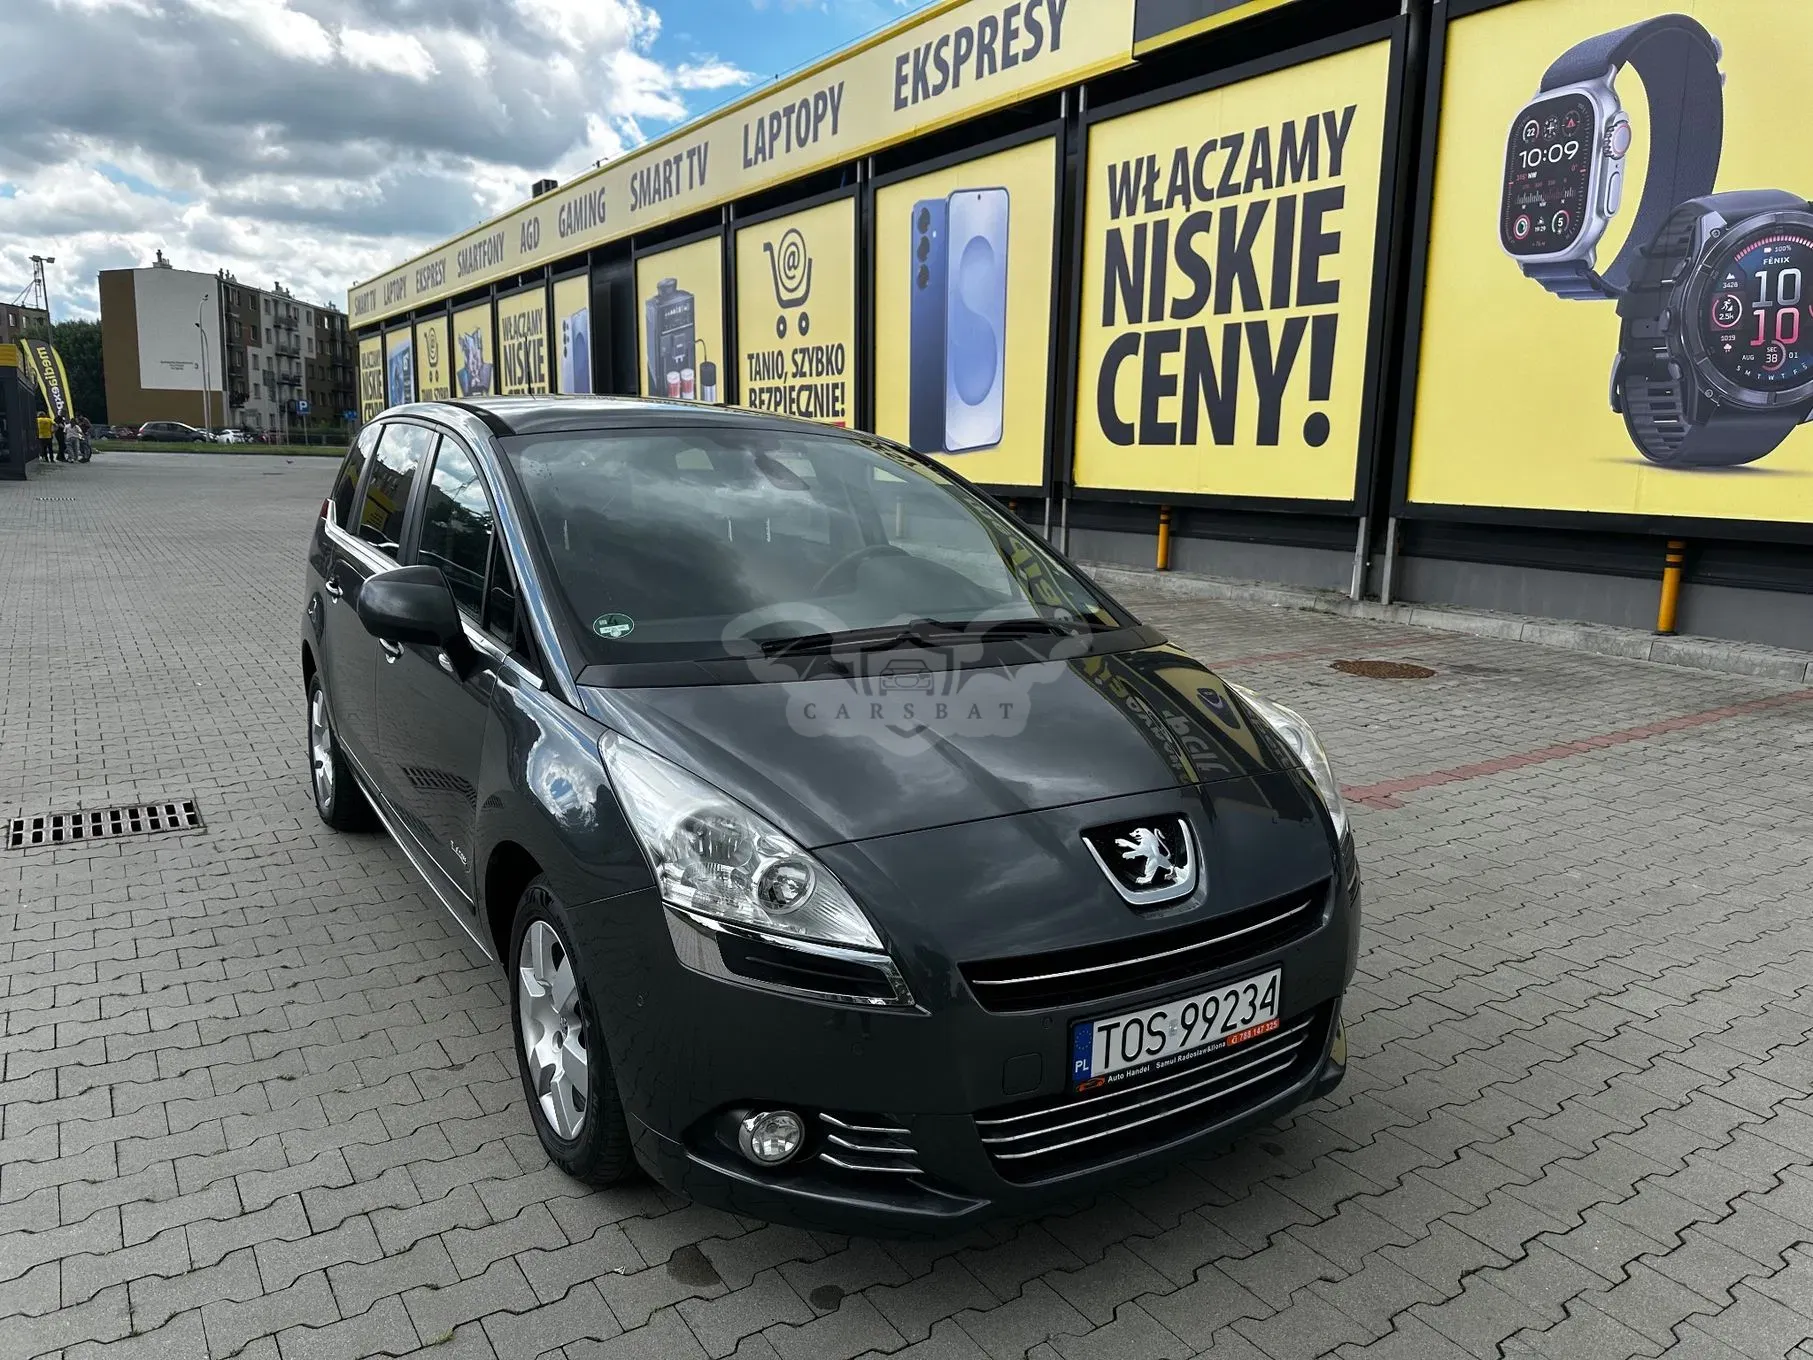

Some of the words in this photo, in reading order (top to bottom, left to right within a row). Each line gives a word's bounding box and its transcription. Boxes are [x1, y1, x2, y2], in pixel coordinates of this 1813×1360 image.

[383, 275, 407, 306] LAPTOPY
[415, 257, 446, 294] EKSPRESY
[457, 231, 505, 278] SMARTFONY
[520, 216, 540, 254] AGD
[558, 187, 606, 238] GAMING
[630, 152, 683, 212] SMART
[686, 141, 709, 187] TV
[742, 81, 845, 170] LAPTOPY
[893, 0, 1067, 113] EKSPRESY
[1107, 104, 1357, 220] WŁĄCZAMY
[1519, 140, 1579, 169] 10:09
[1557, 217, 1564, 227] 5
[1102, 185, 1346, 327] NISKIE
[1752, 268, 1801, 308] 10
[1750, 307, 1800, 346] 10
[503, 337, 546, 387] NISKIE
[747, 350, 788, 384] TANIO,
[791, 342, 845, 379] SZYBKO
[1765, 353, 1778, 363] 38
[749, 381, 846, 418] BEZPIECZNIE!
[1096, 312, 1339, 448] CENY!
[299, 400, 308, 411] P
[1097, 1011, 1169, 1069] TOS
[1178, 975, 1278, 1048] 99234
[1074, 1060, 1090, 1073] PL
[1107, 1073, 1125, 1084] Auto
[1126, 1064, 1150, 1078] Handel
